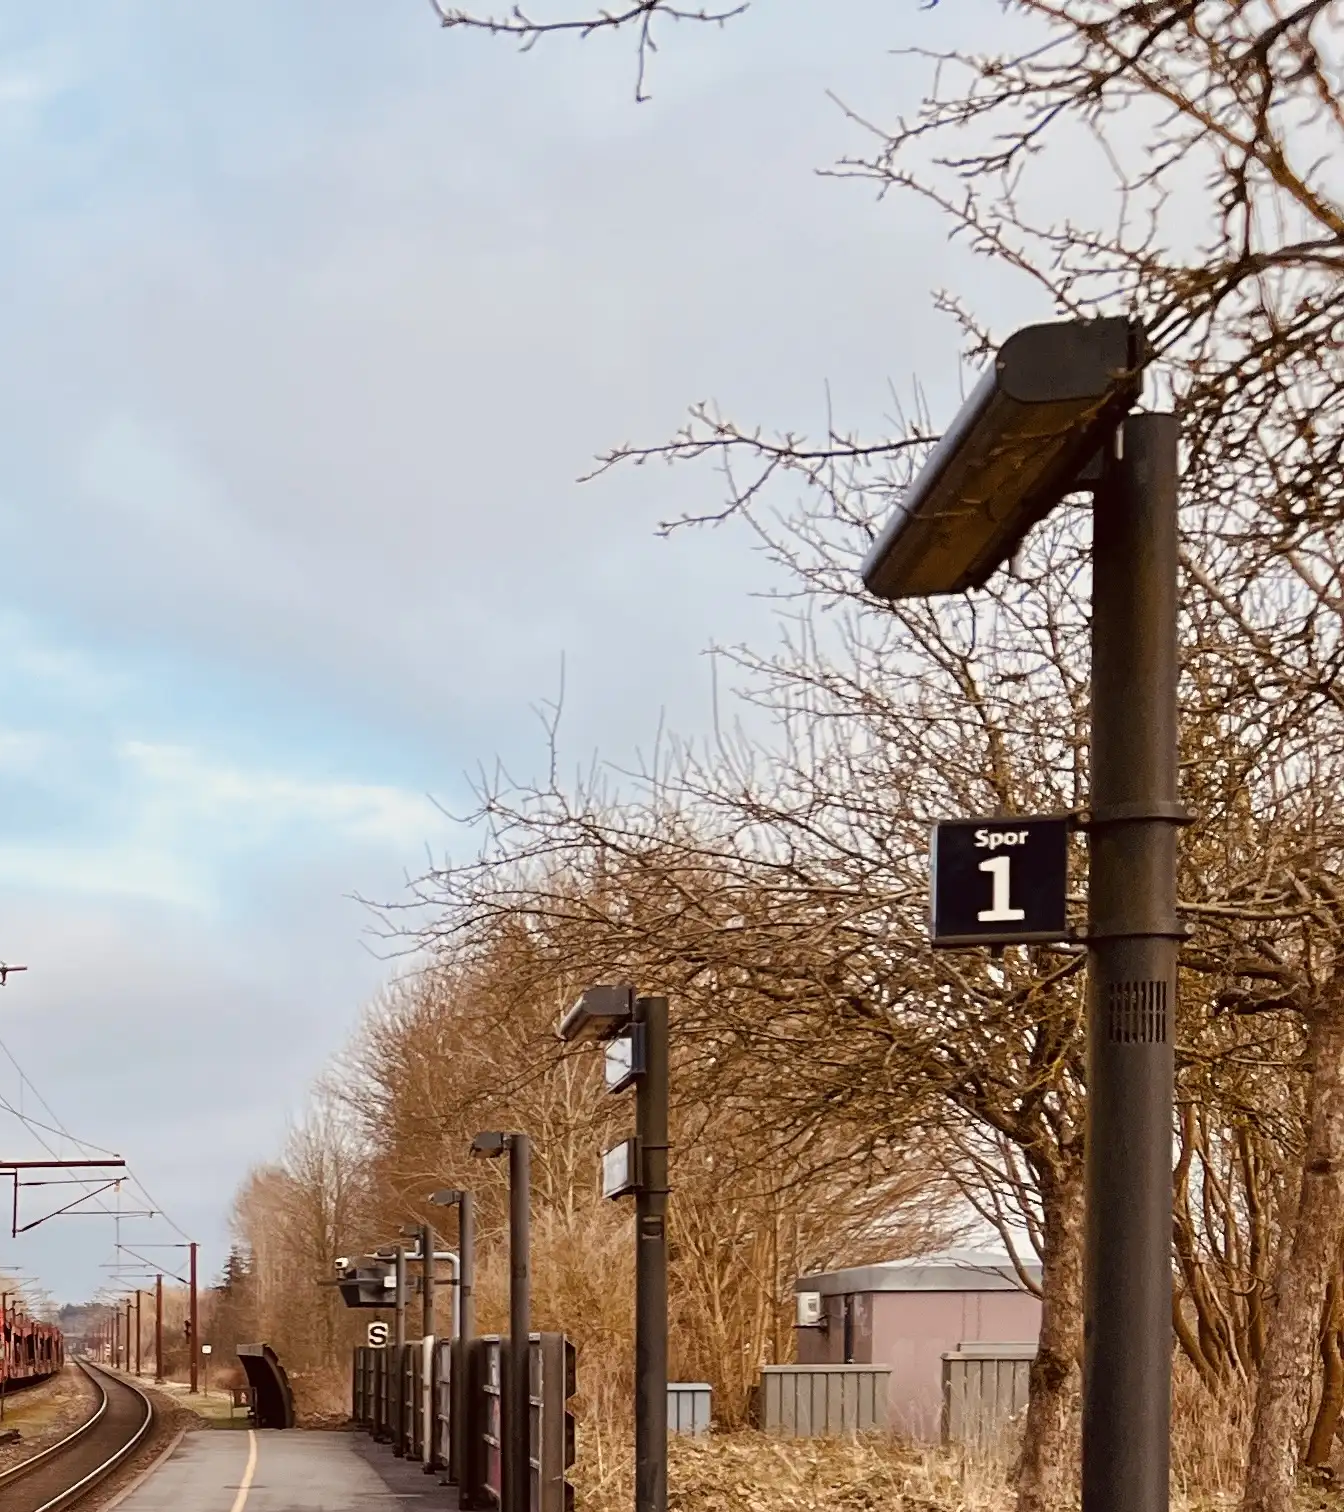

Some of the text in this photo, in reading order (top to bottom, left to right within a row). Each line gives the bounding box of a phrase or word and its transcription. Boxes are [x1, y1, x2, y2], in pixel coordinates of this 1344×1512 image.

[974, 828, 1029, 850] Spor
[977, 855, 1025, 922] 1
[369, 1325, 387, 1345] S
